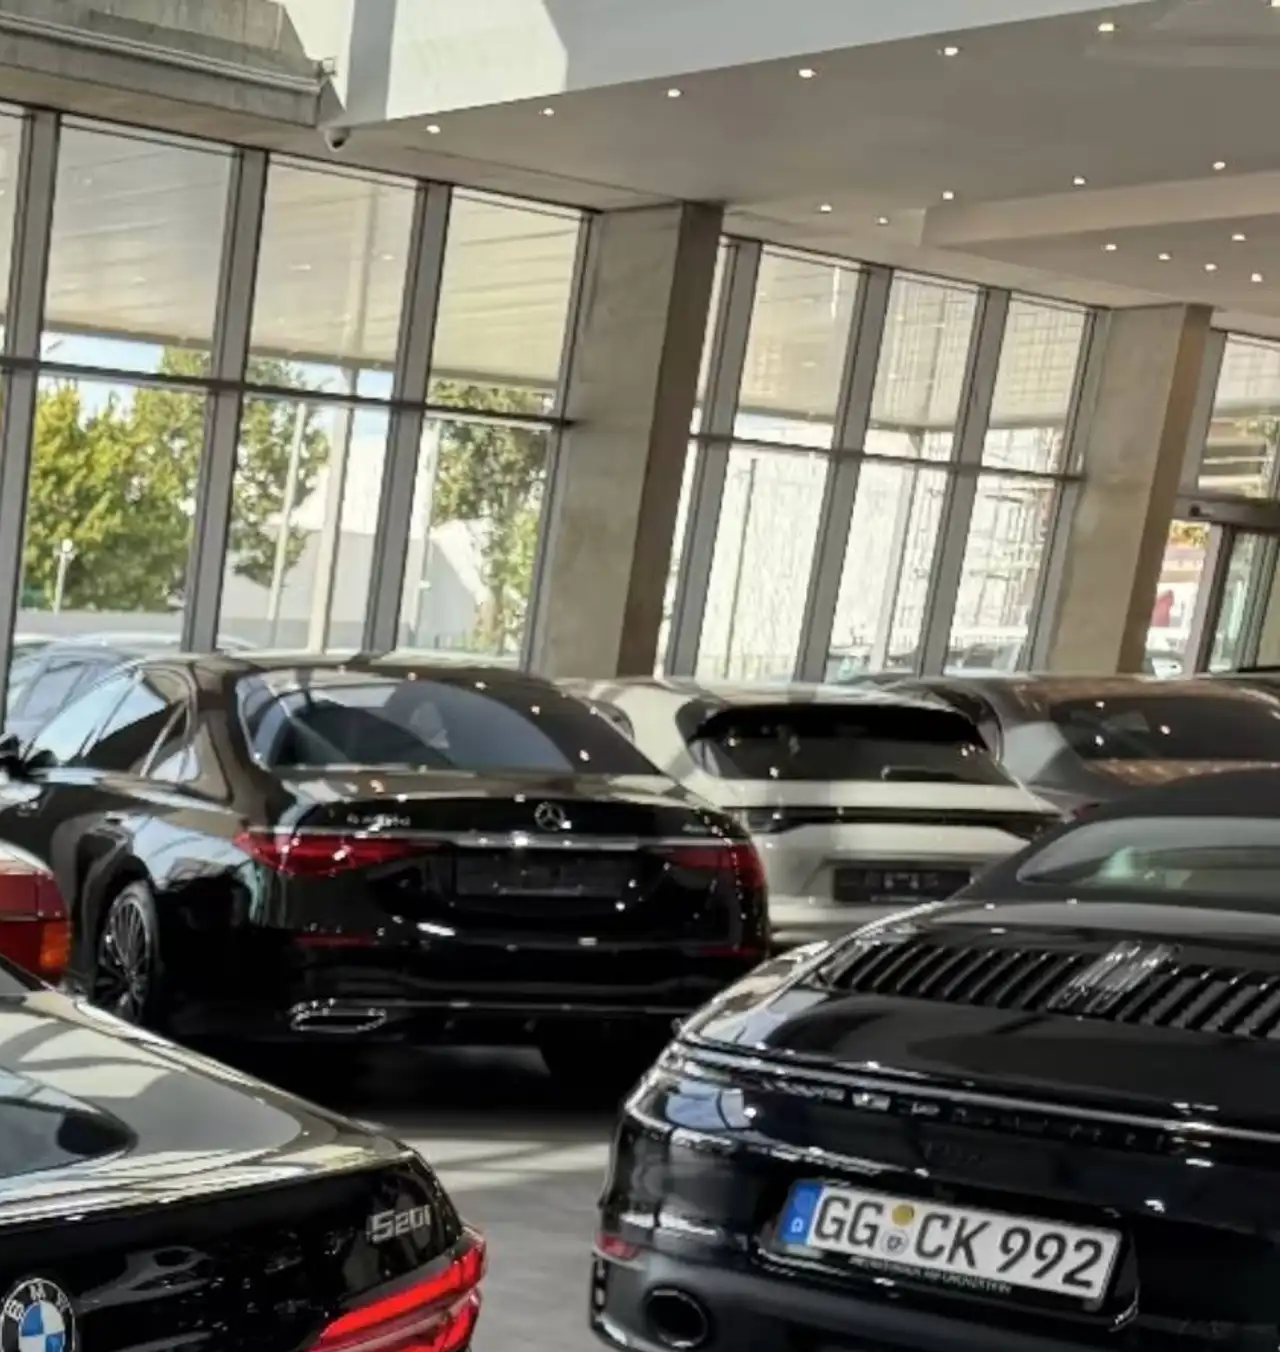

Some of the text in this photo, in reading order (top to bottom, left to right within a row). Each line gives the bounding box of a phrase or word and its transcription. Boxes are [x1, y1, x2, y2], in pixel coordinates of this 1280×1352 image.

[814, 1195, 884, 1249] GG
[915, 1211, 992, 1270] CK
[996, 1226, 1105, 1289] 992
[4, 1282, 71, 1321] BMW
